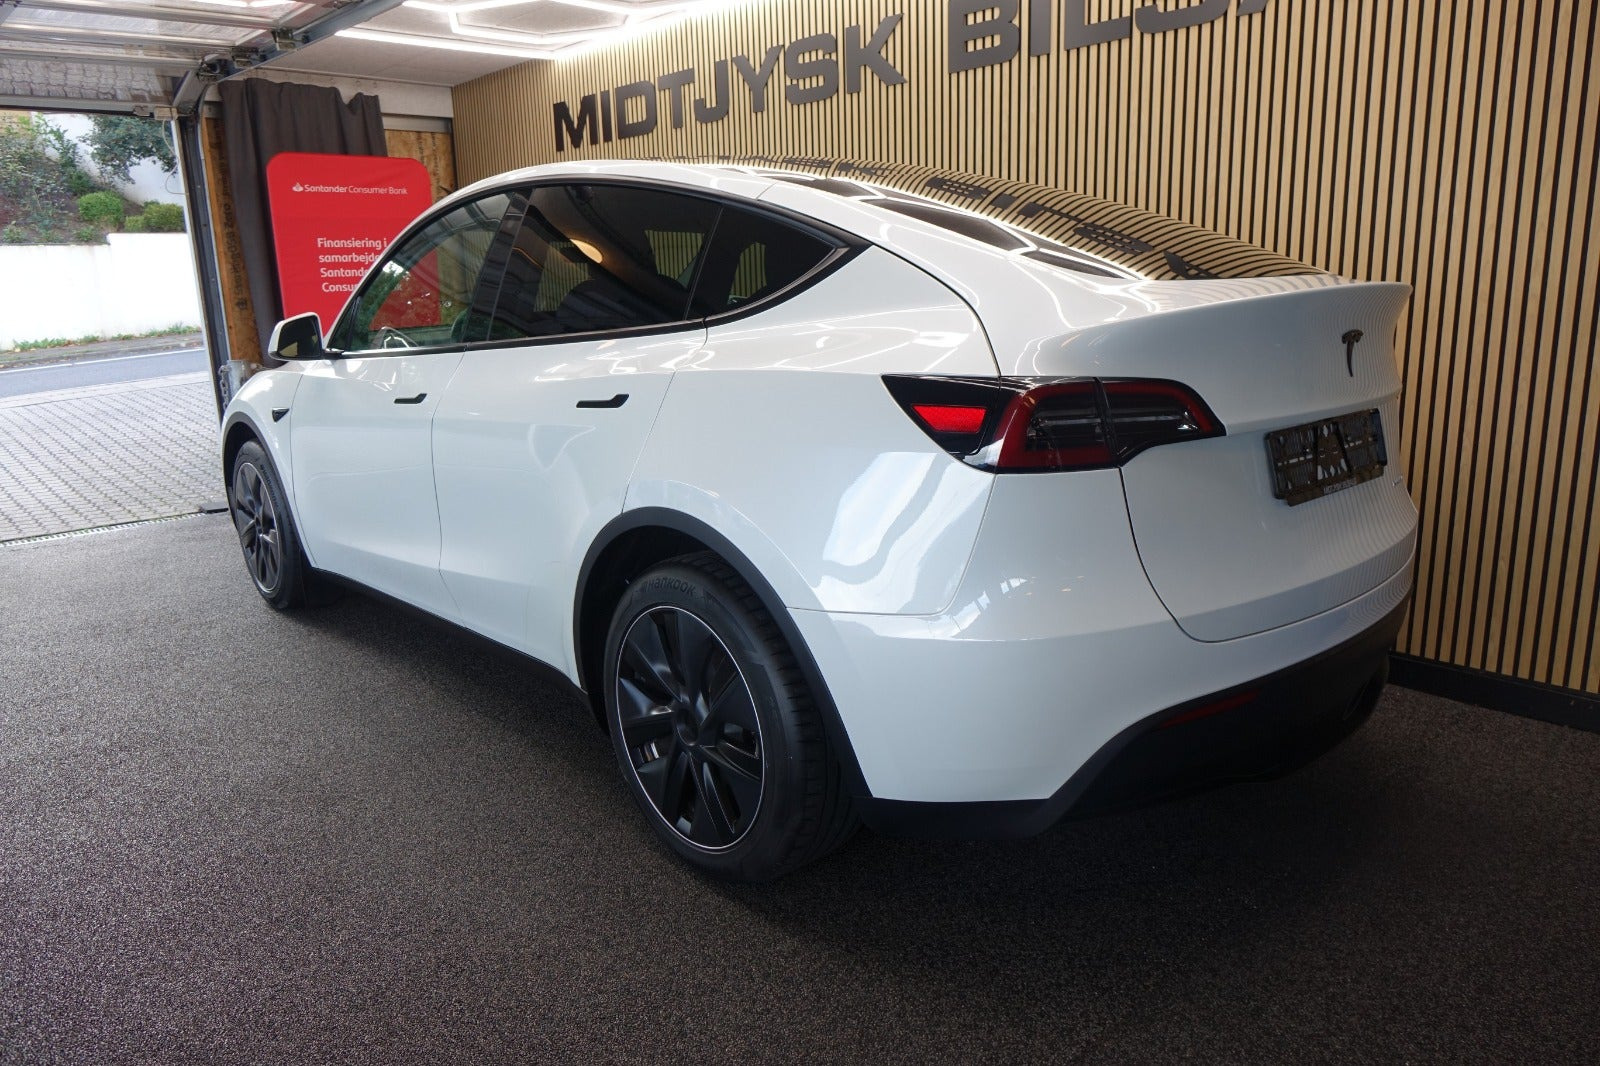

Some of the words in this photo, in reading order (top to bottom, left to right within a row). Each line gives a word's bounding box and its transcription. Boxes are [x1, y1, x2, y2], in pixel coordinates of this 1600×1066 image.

[555, 14, 904, 151] MIDTJYSK
[305, 185, 347, 193] Santander
[349, 186, 387, 194] Consumer
[389, 187, 408, 195] Bank
[317, 238, 381, 250] Finansiering
[383, 238, 388, 247] i
